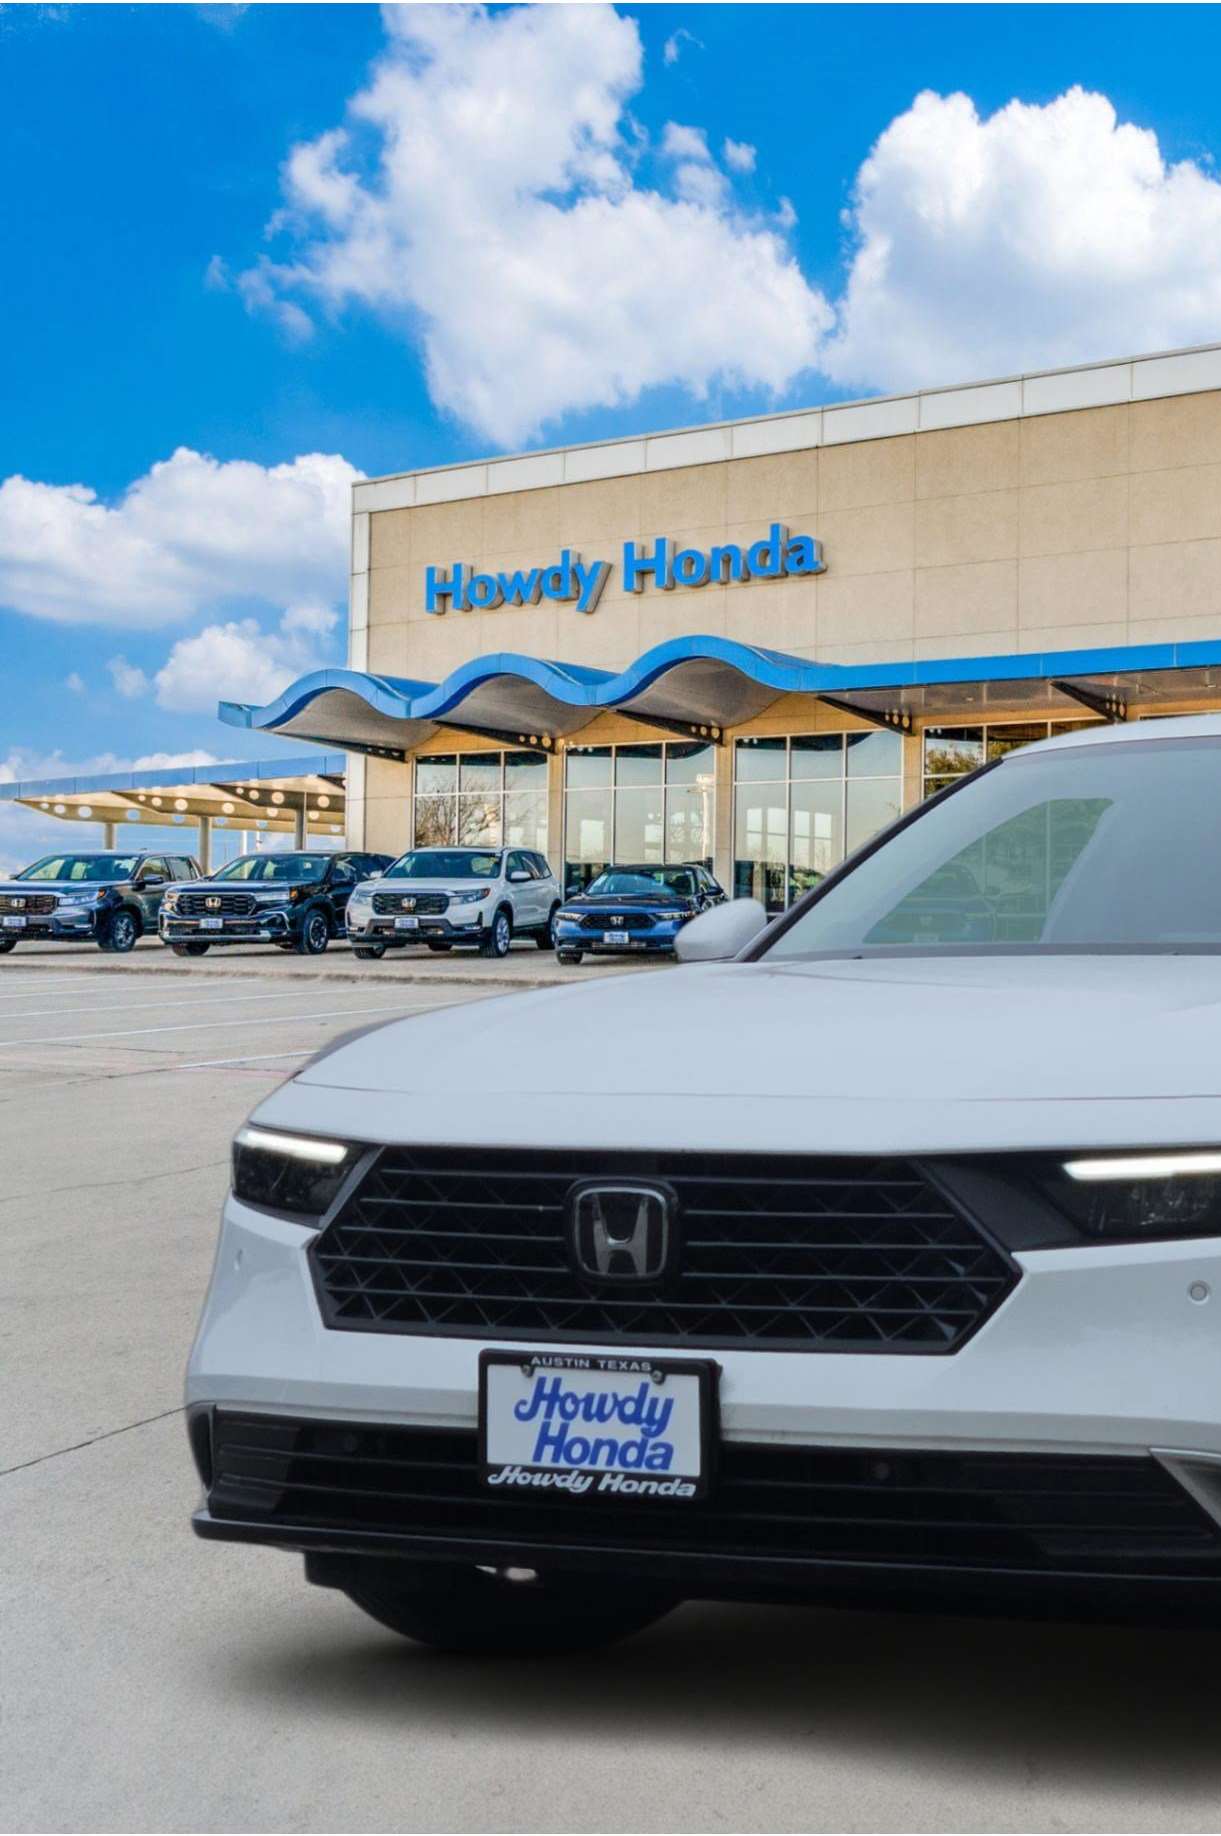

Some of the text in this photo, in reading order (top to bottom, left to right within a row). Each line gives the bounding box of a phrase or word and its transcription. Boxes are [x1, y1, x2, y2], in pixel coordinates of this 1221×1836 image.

[425, 522, 828, 616] Howdy Honda
[530, 1355, 652, 1373] AUSTIN TEXAS
[513, 1375, 674, 1438] Howdy
[532, 1421, 674, 1471] Honda
[487, 1465, 697, 1497] Howdy Honda
